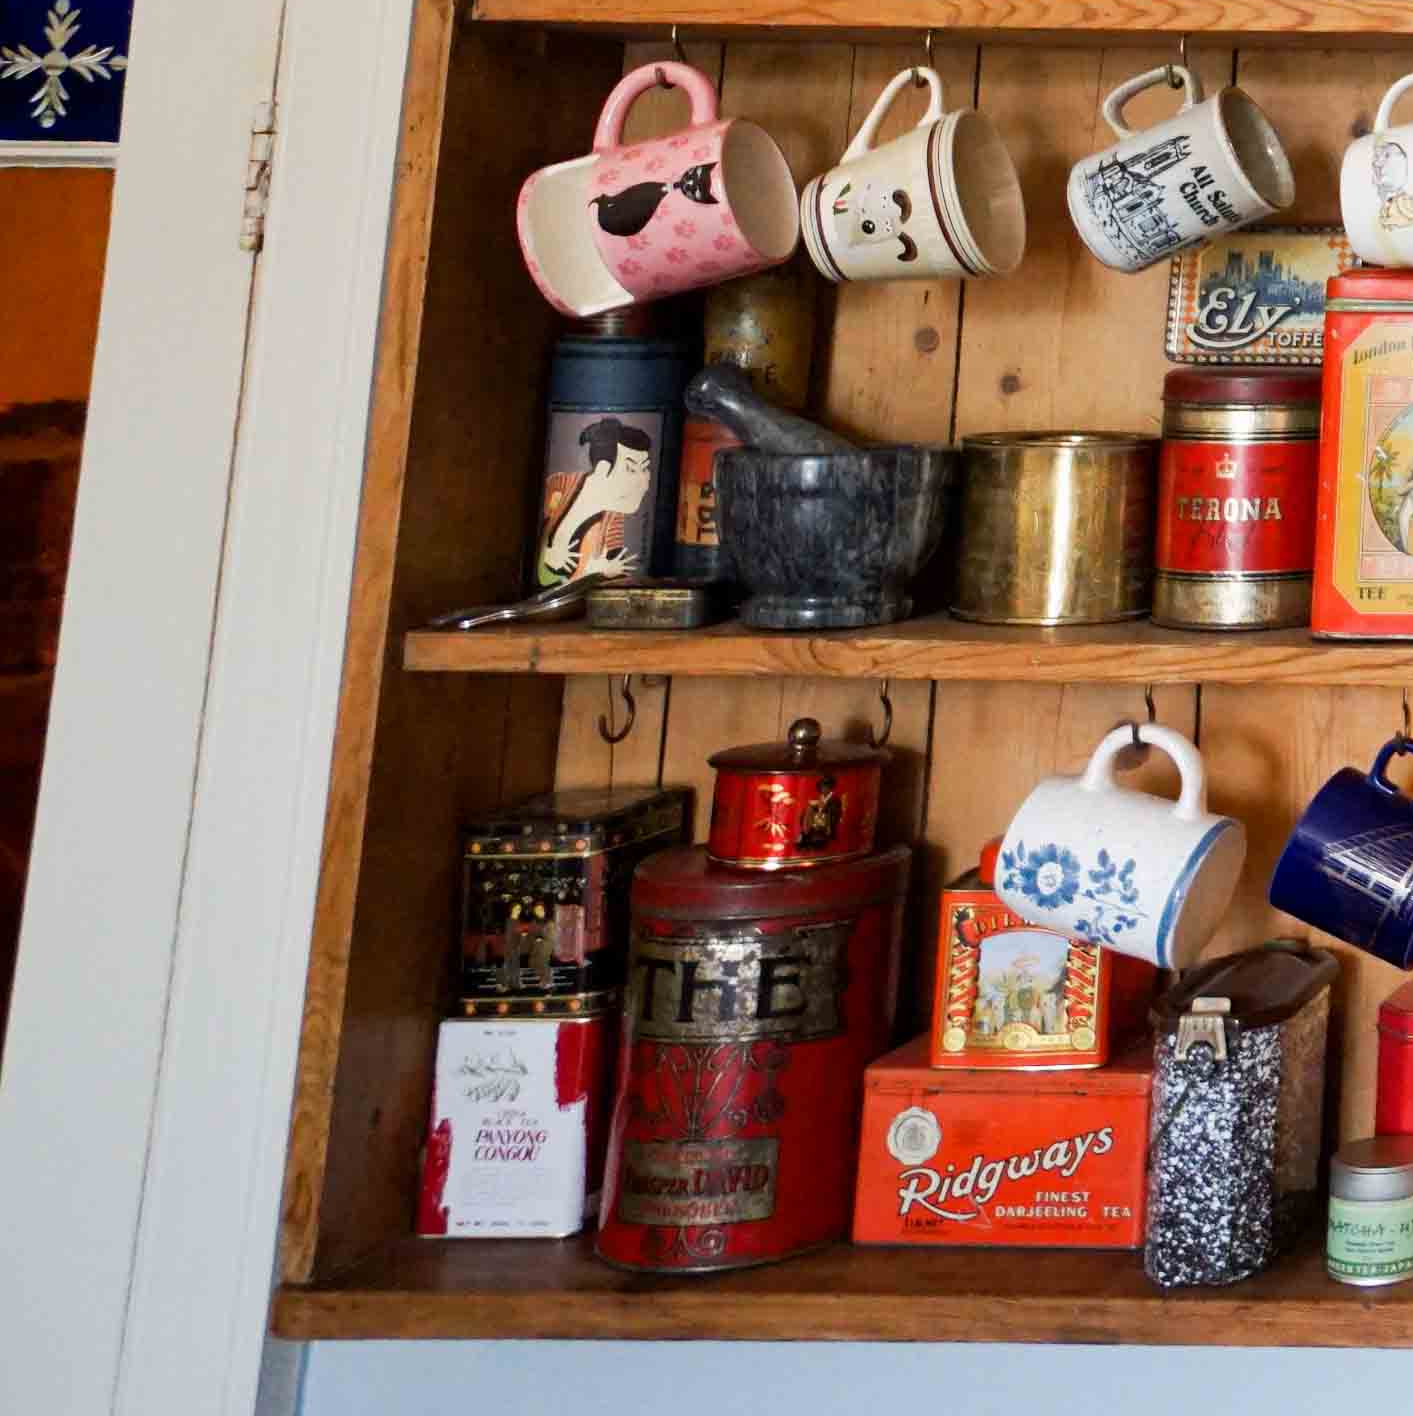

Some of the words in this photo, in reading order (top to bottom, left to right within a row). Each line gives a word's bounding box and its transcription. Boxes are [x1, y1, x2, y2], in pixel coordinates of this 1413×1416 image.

[1266, 330, 1325, 349] TOFFE
[1175, 497, 1283, 522] TERONA
[475, 1129, 549, 1146] PANYONG
[474, 1145, 541, 1162] CONGOU
[898, 1126, 1114, 1221] Ridgways
[1034, 1191, 1091, 1203] FINEST
[994, 1205, 1089, 1218] DARJEELING
[1102, 1206, 1132, 1218] TEA
